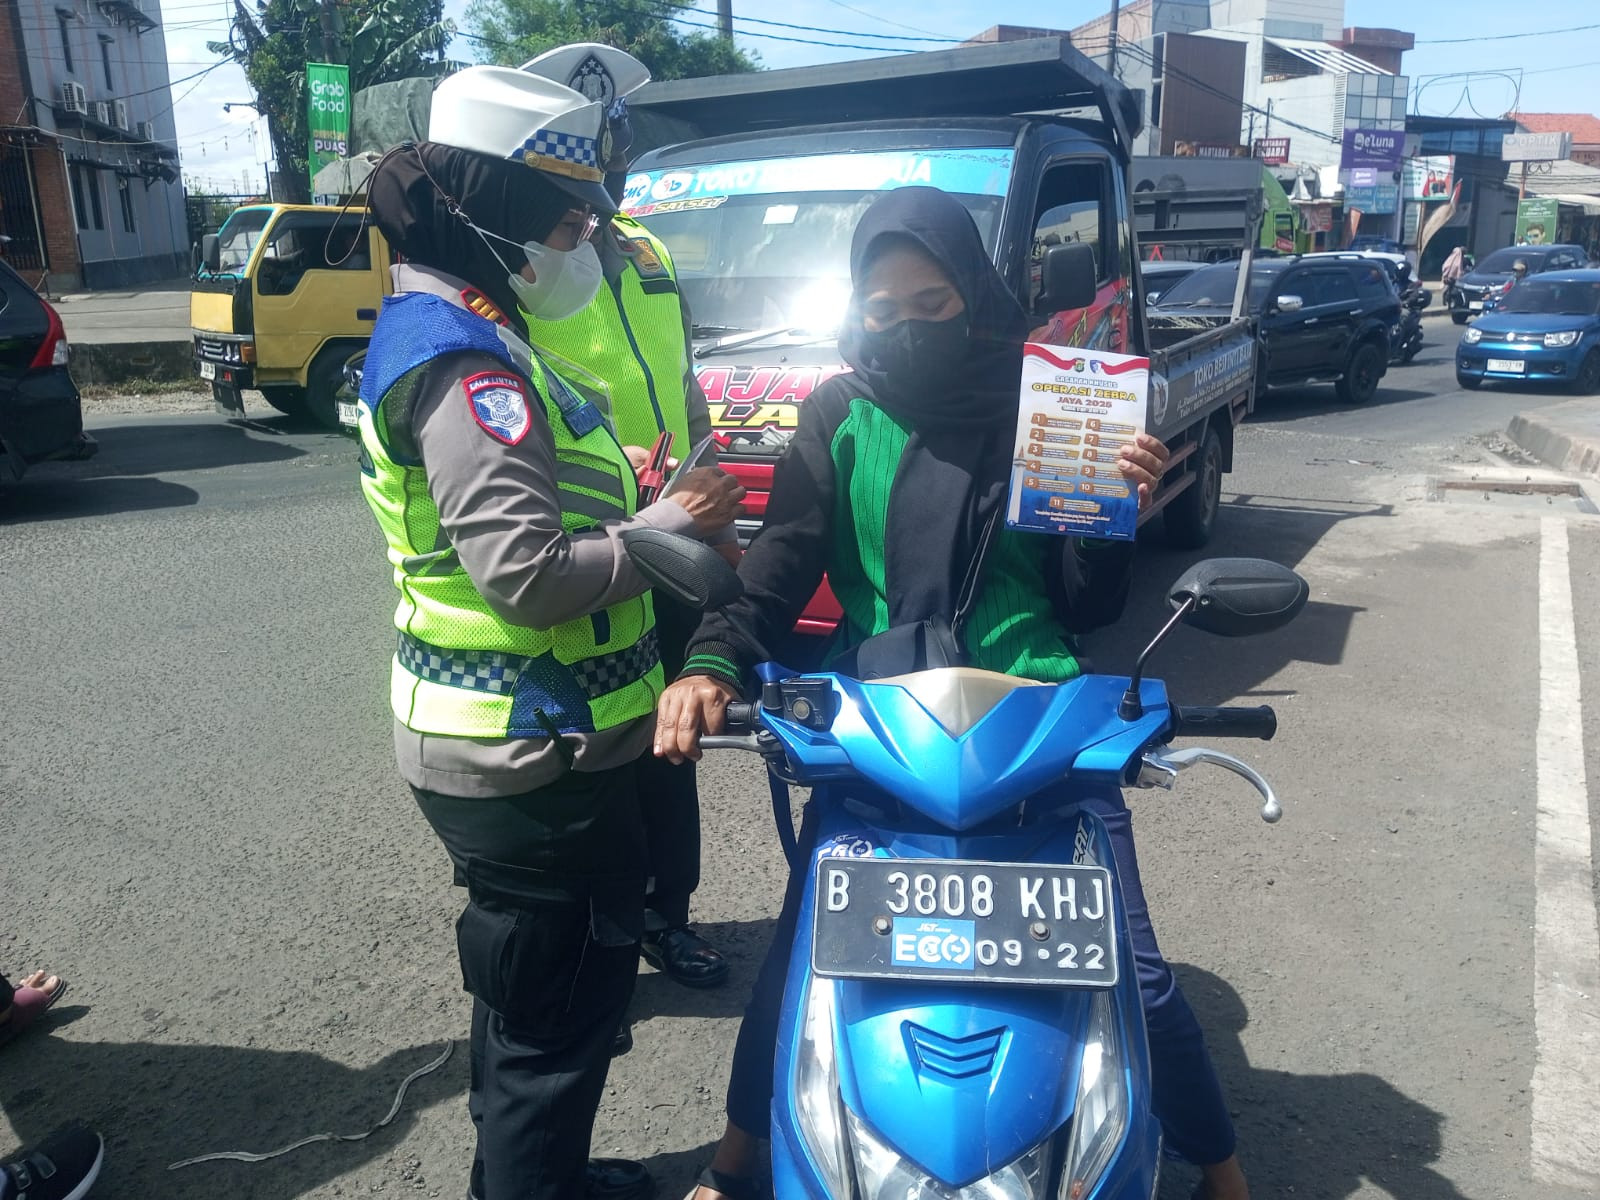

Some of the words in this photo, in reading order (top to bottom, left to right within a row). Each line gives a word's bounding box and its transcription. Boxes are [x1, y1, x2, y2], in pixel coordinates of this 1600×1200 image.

[311, 80, 345, 96] Grab
[312, 97, 345, 112] Food
[314, 139, 346, 155] PUAS
[1520, 135, 1557, 145] OPTIK
[1199, 146, 1231, 157] MARTABAK
[694, 167, 753, 192] TOKO
[468, 379, 489, 390] LALU
[491, 377, 519, 388] LINTAS
[1194, 363, 1213, 388] TOKO
[1032, 383, 1091, 396] OPERASI
[1094, 389, 1137, 402] ZEBRA
[1057, 397, 1083, 406] JAYA
[1085, 399, 1112, 408] 2025
[827, 869, 850, 912] B
[886, 872, 994, 917] 3808
[1020, 877, 1104, 920] KHJ
[895, 934, 971, 965] ECO
